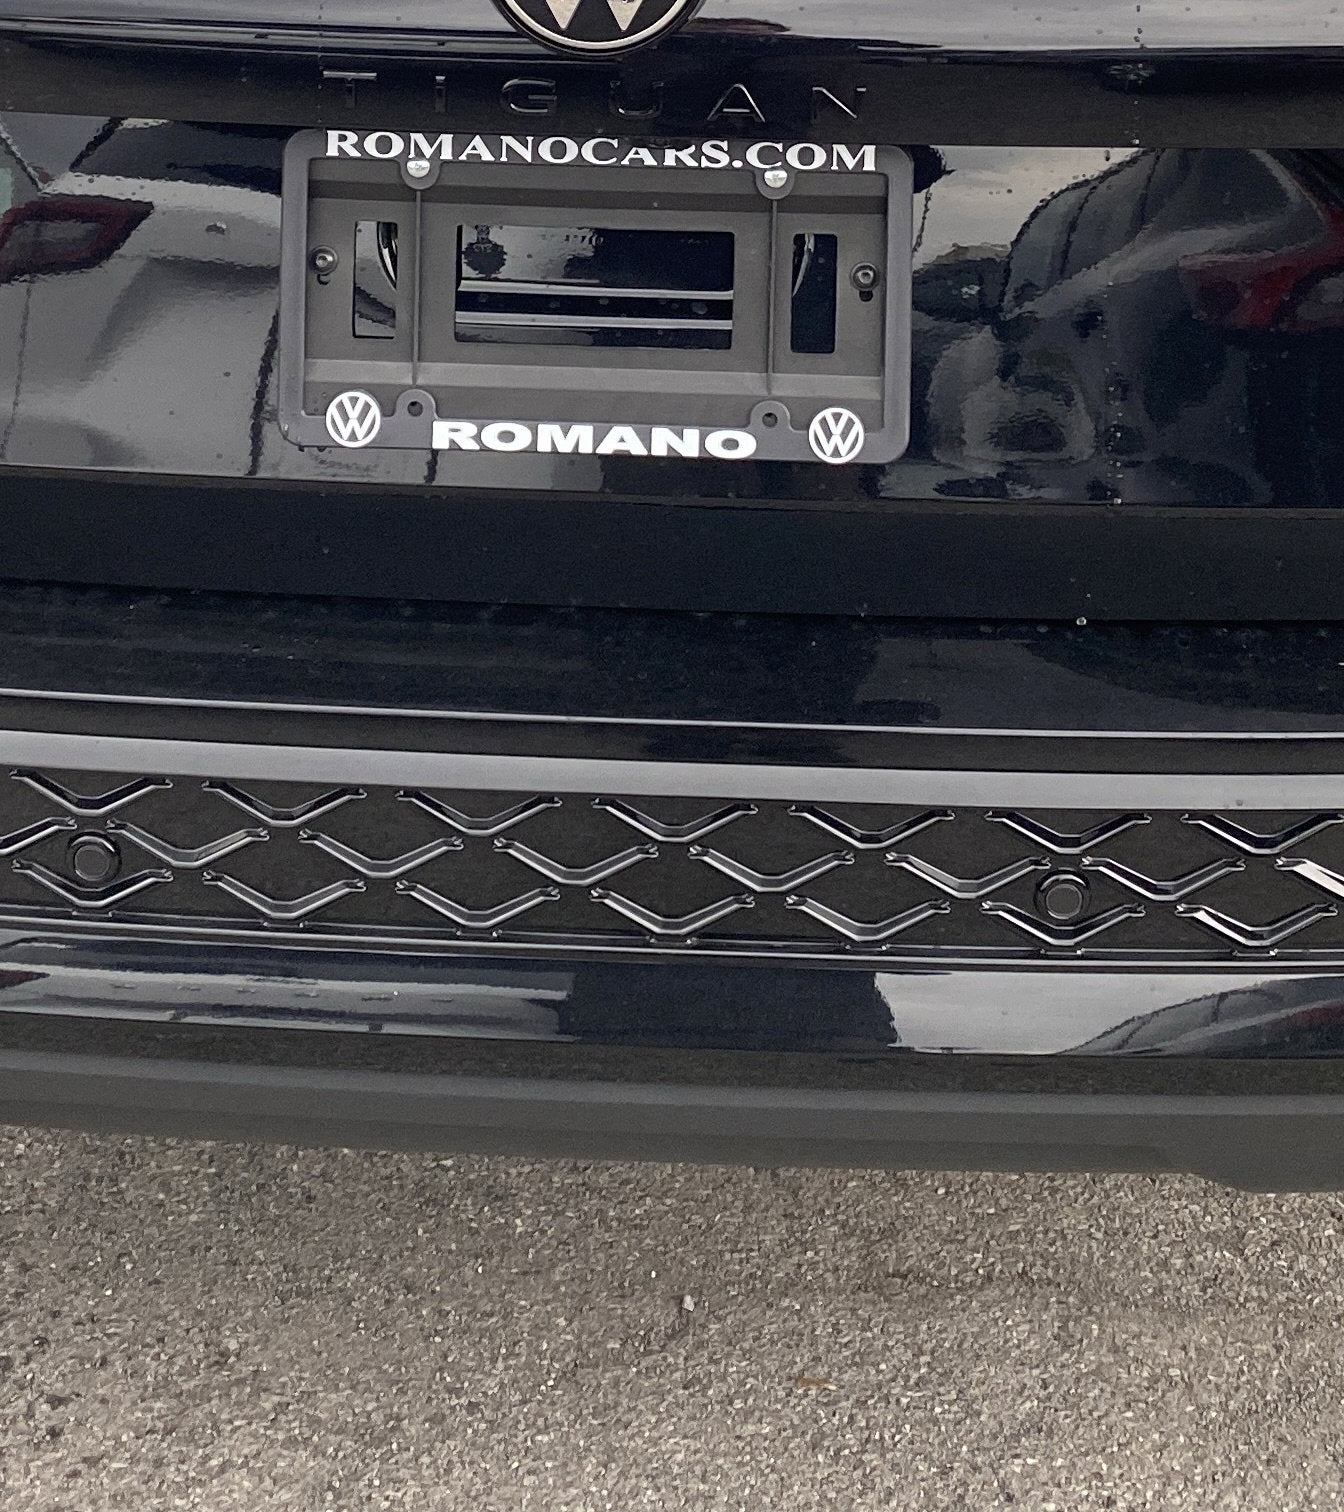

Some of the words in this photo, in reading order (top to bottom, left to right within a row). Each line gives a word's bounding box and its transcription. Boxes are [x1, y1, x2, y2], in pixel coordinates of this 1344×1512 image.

[322, 71, 867, 124] TIGUAN
[324, 129, 878, 172] ROMANOCARS.COM
[325, 391, 382, 448] VW
[431, 419, 758, 459] ROMANO
[808, 407, 865, 465] VW
